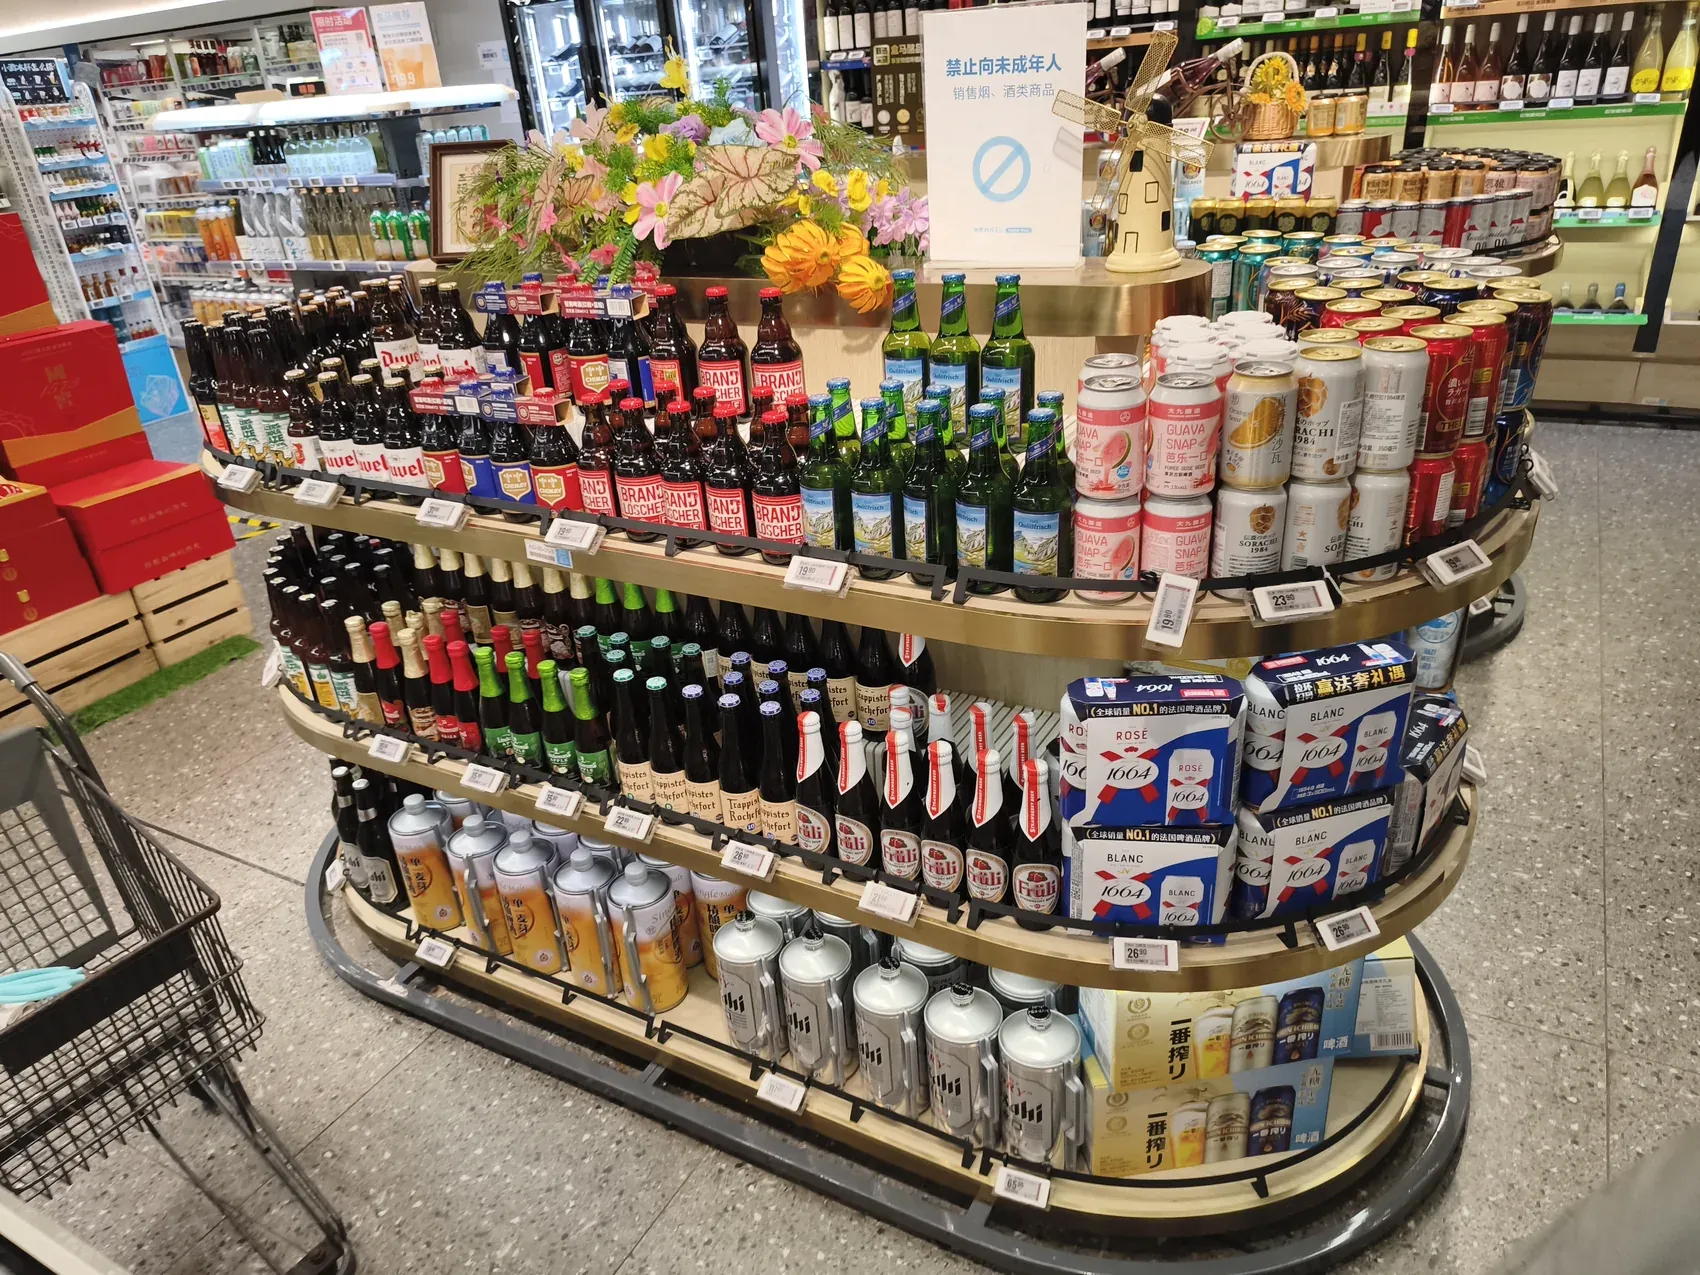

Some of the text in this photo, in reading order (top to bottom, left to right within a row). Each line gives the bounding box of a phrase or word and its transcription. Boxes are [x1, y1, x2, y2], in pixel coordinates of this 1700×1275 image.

[946, 53, 1062, 77] 禁止向未成年人
[953, 84, 1055, 100] 销售烟、酒类商品
[381, 350, 420, 367] Duve
[1167, 423, 1205, 436] GUAVA
[1295, 427, 1335, 437] RACHI
[1166, 438, 1198, 450] SNAP
[326, 449, 359, 469] uvel
[1077, 452, 1103, 466] 乐一口
[1166, 451, 1208, 463] 芭乐一口
[390, 458, 425, 478] uvel
[756, 504, 801, 523] BRAND
[1077, 532, 1108, 546] GUAVA
[1175, 533, 1208, 546] GUAVA
[1239, 538, 1278, 547] SORACHI
[1077, 545, 1100, 557] SNAP
[1175, 549, 1201, 559] SNAP
[1315, 653, 1351, 667] 1664
[1132, 703, 1158, 715] NO.1
[1247, 701, 1286, 720] BLANC
[1310, 707, 1345, 722] BLANC
[1116, 728, 1148, 741] ROSÉ
[1364, 727, 1389, 738] BLANC
[1300, 743, 1343, 763] 1664
[1355, 753, 1386, 768] 1664
[1063, 759, 1087, 780] 166
[1106, 765, 1153, 781] 1664
[1172, 790, 1205, 803] 1664
[1311, 804, 1333, 819] NO.1
[1126, 828, 1150, 841] NO.1
[1295, 831, 1327, 846] BLANC
[884, 843, 918, 863] Früli
[1107, 853, 1144, 864] BLANC
[1345, 853, 1368, 864] BLANC
[923, 855, 957, 875] Früli
[1286, 863, 1326, 882] 1664
[968, 864, 1002, 886] Früli
[1018, 879, 1056, 898] Früli
[1338, 877, 1365, 891] 1664
[1101, 885, 1145, 900] 1664
[1168, 889, 1196, 897] BLANC
[1164, 911, 1196, 923] 1664
[1168, 1018, 1192, 1081] 一番搾り
[1323, 1035, 1349, 1050] 啤酒
[1146, 1112, 1168, 1169] 一番搾り
[1295, 1130, 1320, 1144] 啤酒
